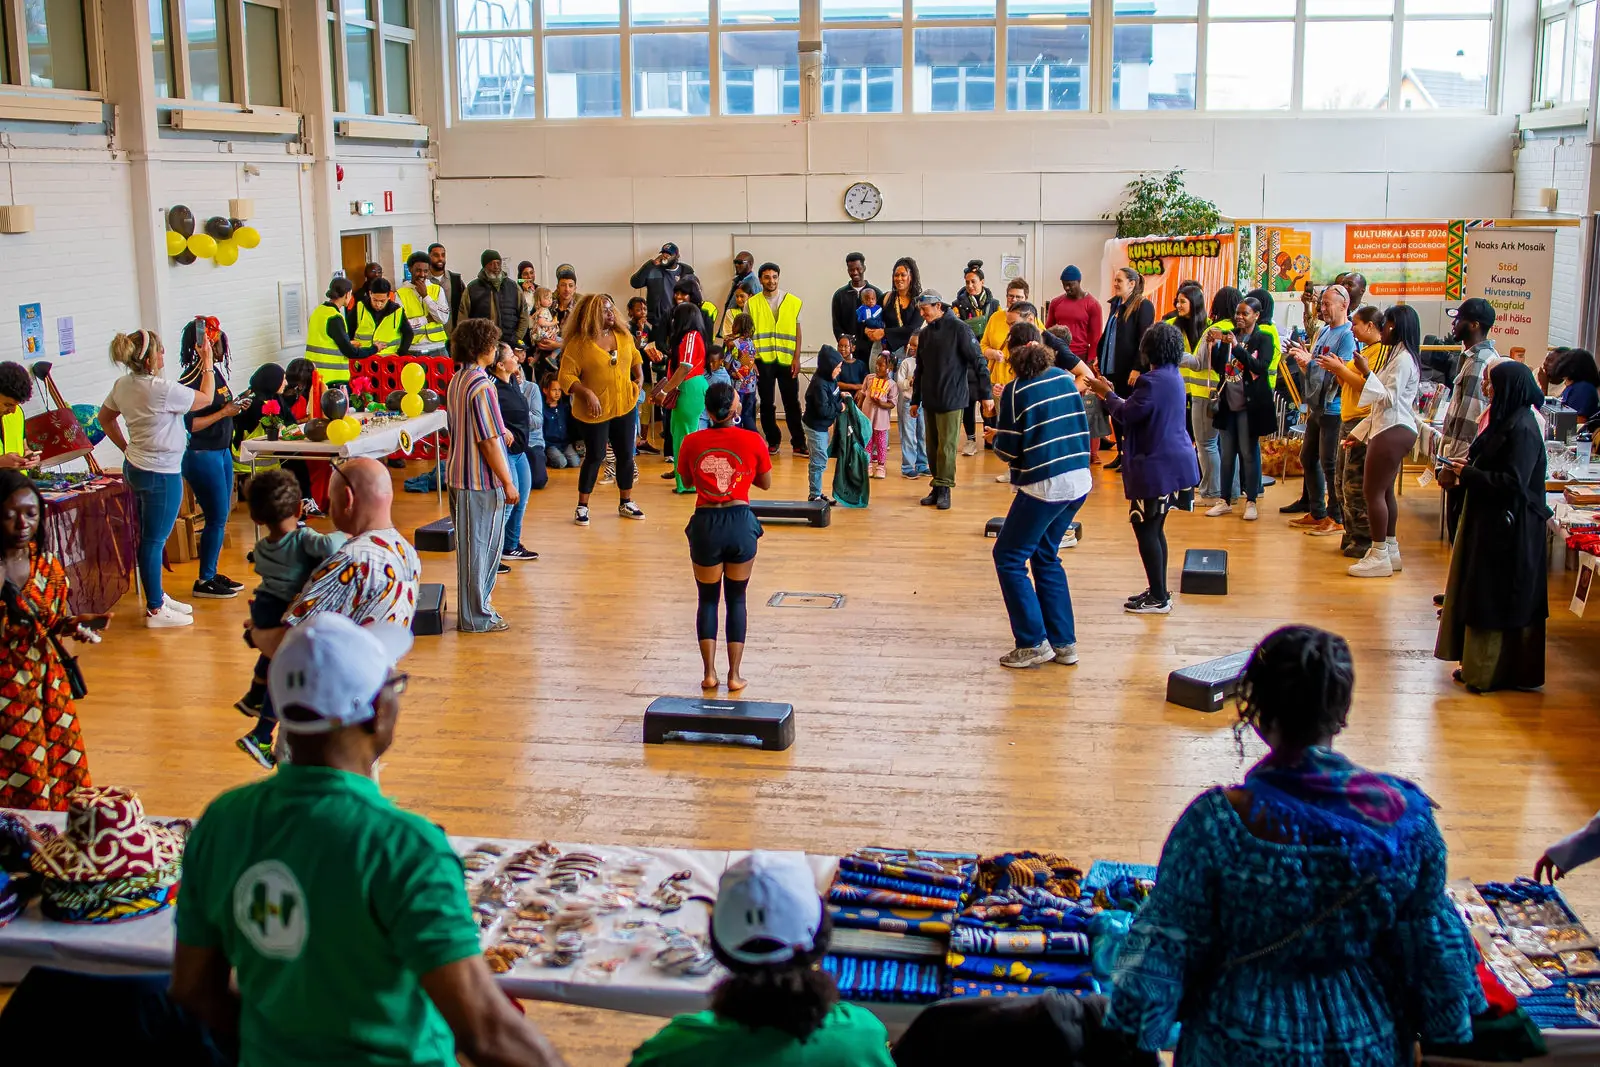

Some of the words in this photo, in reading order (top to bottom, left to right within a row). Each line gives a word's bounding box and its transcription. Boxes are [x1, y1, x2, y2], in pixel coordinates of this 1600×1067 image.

[1353, 230, 1426, 238] KULTURKALASET
[1427, 229, 1447, 238] 2026
[1128, 240, 1219, 259] KULTURKALASET
[1475, 241, 1499, 250] Noaks
[1501, 241, 1515, 250] Ark
[1517, 242, 1546, 252] Mosaik
[1129, 260, 1162, 274] 2026
[1498, 262, 1518, 271] Stöd
[1491, 274, 1526, 286] Kunskap
[1484, 287, 1531, 299] Hivtestning
[1509, 313, 1532, 323] hälsa
[1504, 326, 1520, 335] alla
